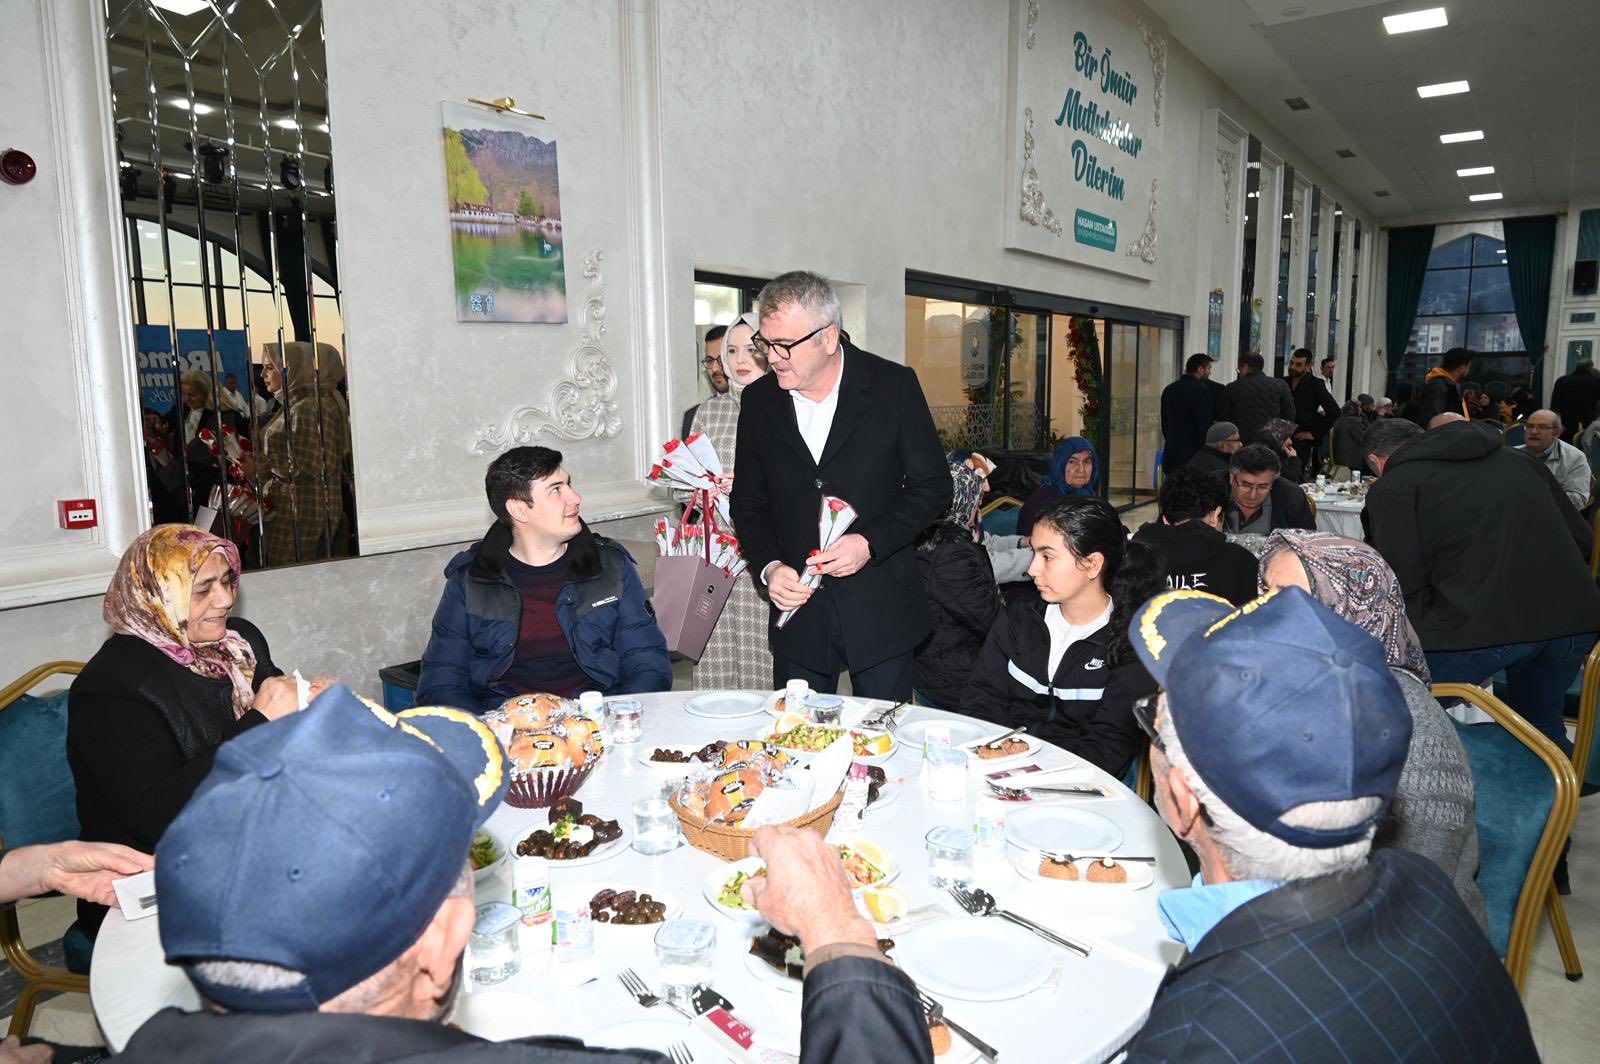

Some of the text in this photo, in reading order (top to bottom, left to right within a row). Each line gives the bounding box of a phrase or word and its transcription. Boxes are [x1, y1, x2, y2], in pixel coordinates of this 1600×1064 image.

[1073, 31, 1137, 106] Bir Ömür
[1071, 139, 1126, 201] Dilerim
[1077, 215, 1094, 230] HASAN
[1090, 657, 1105, 668] NIKE
